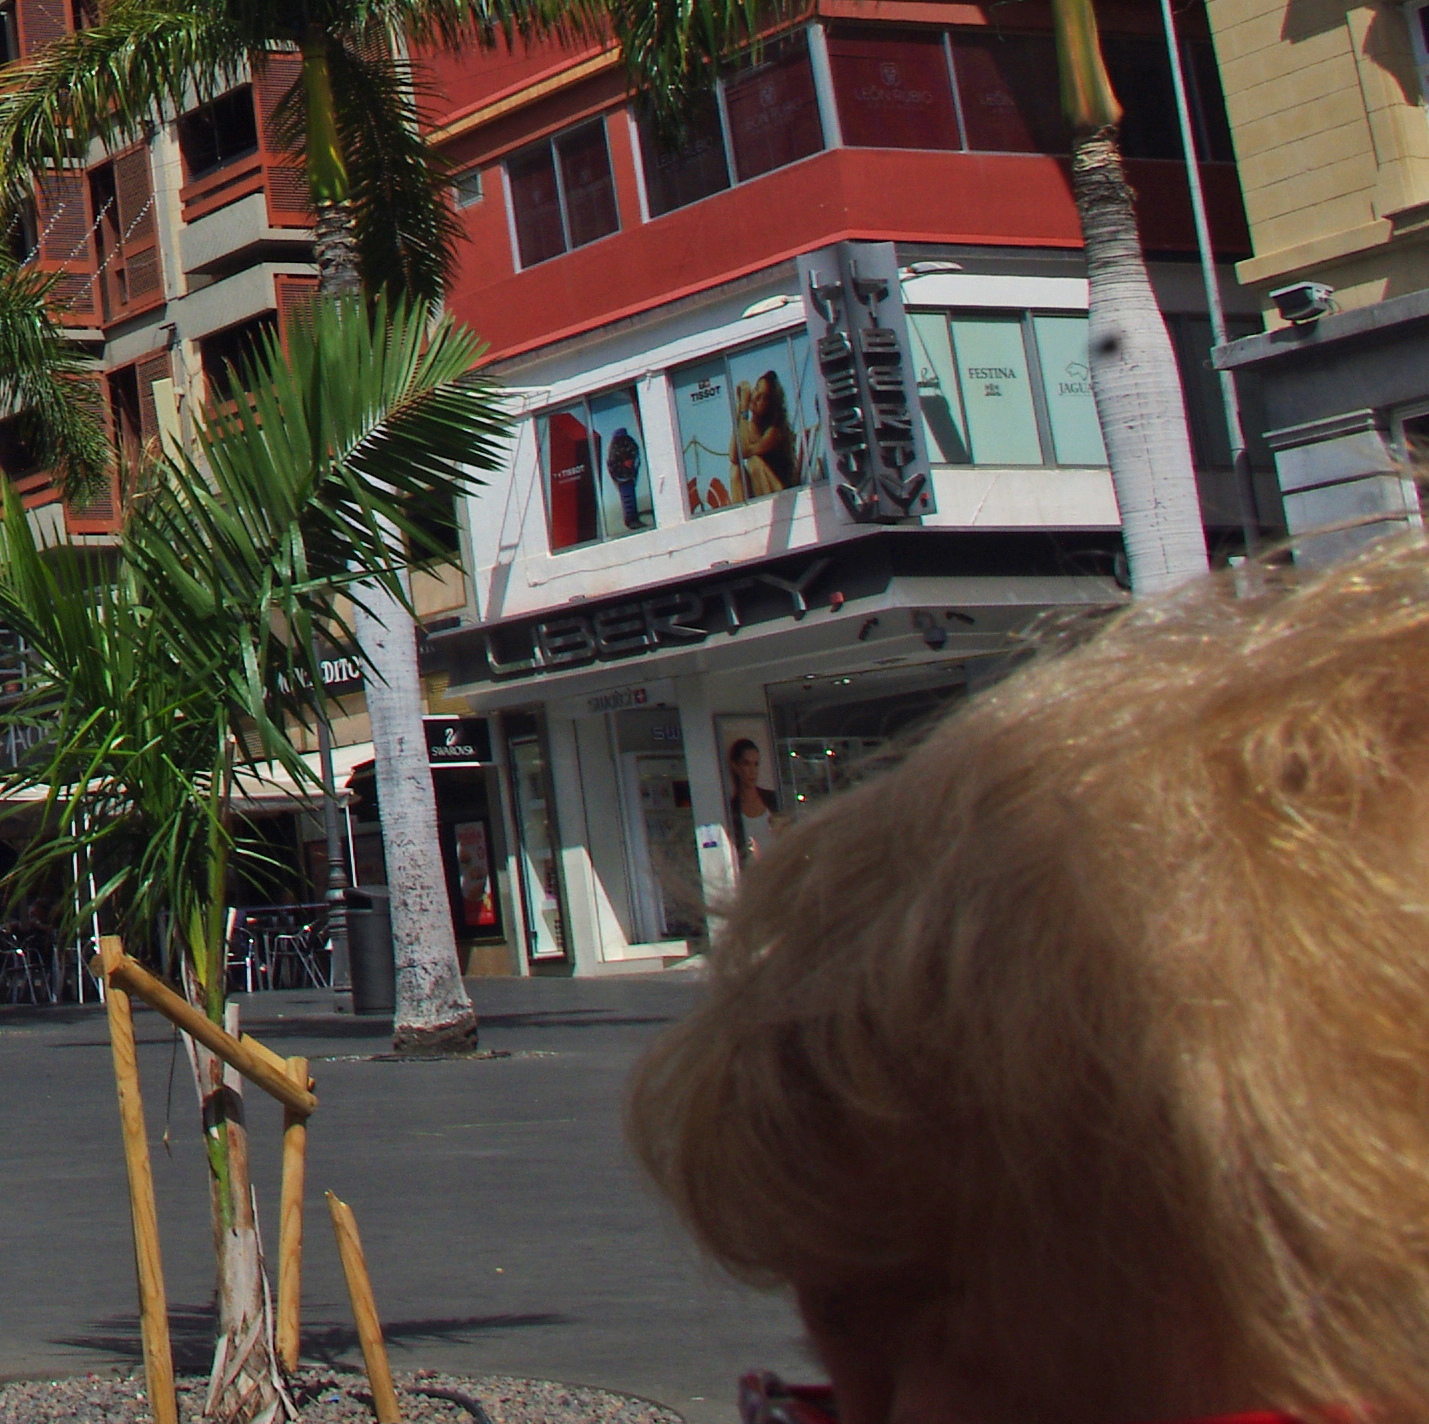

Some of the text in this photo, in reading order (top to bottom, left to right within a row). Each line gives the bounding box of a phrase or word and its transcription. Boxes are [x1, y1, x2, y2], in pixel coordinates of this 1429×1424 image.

[967, 367, 1017, 379] FESTINA
[690, 385, 721, 401] TISSOT
[561, 464, 585, 478] TISSOT
